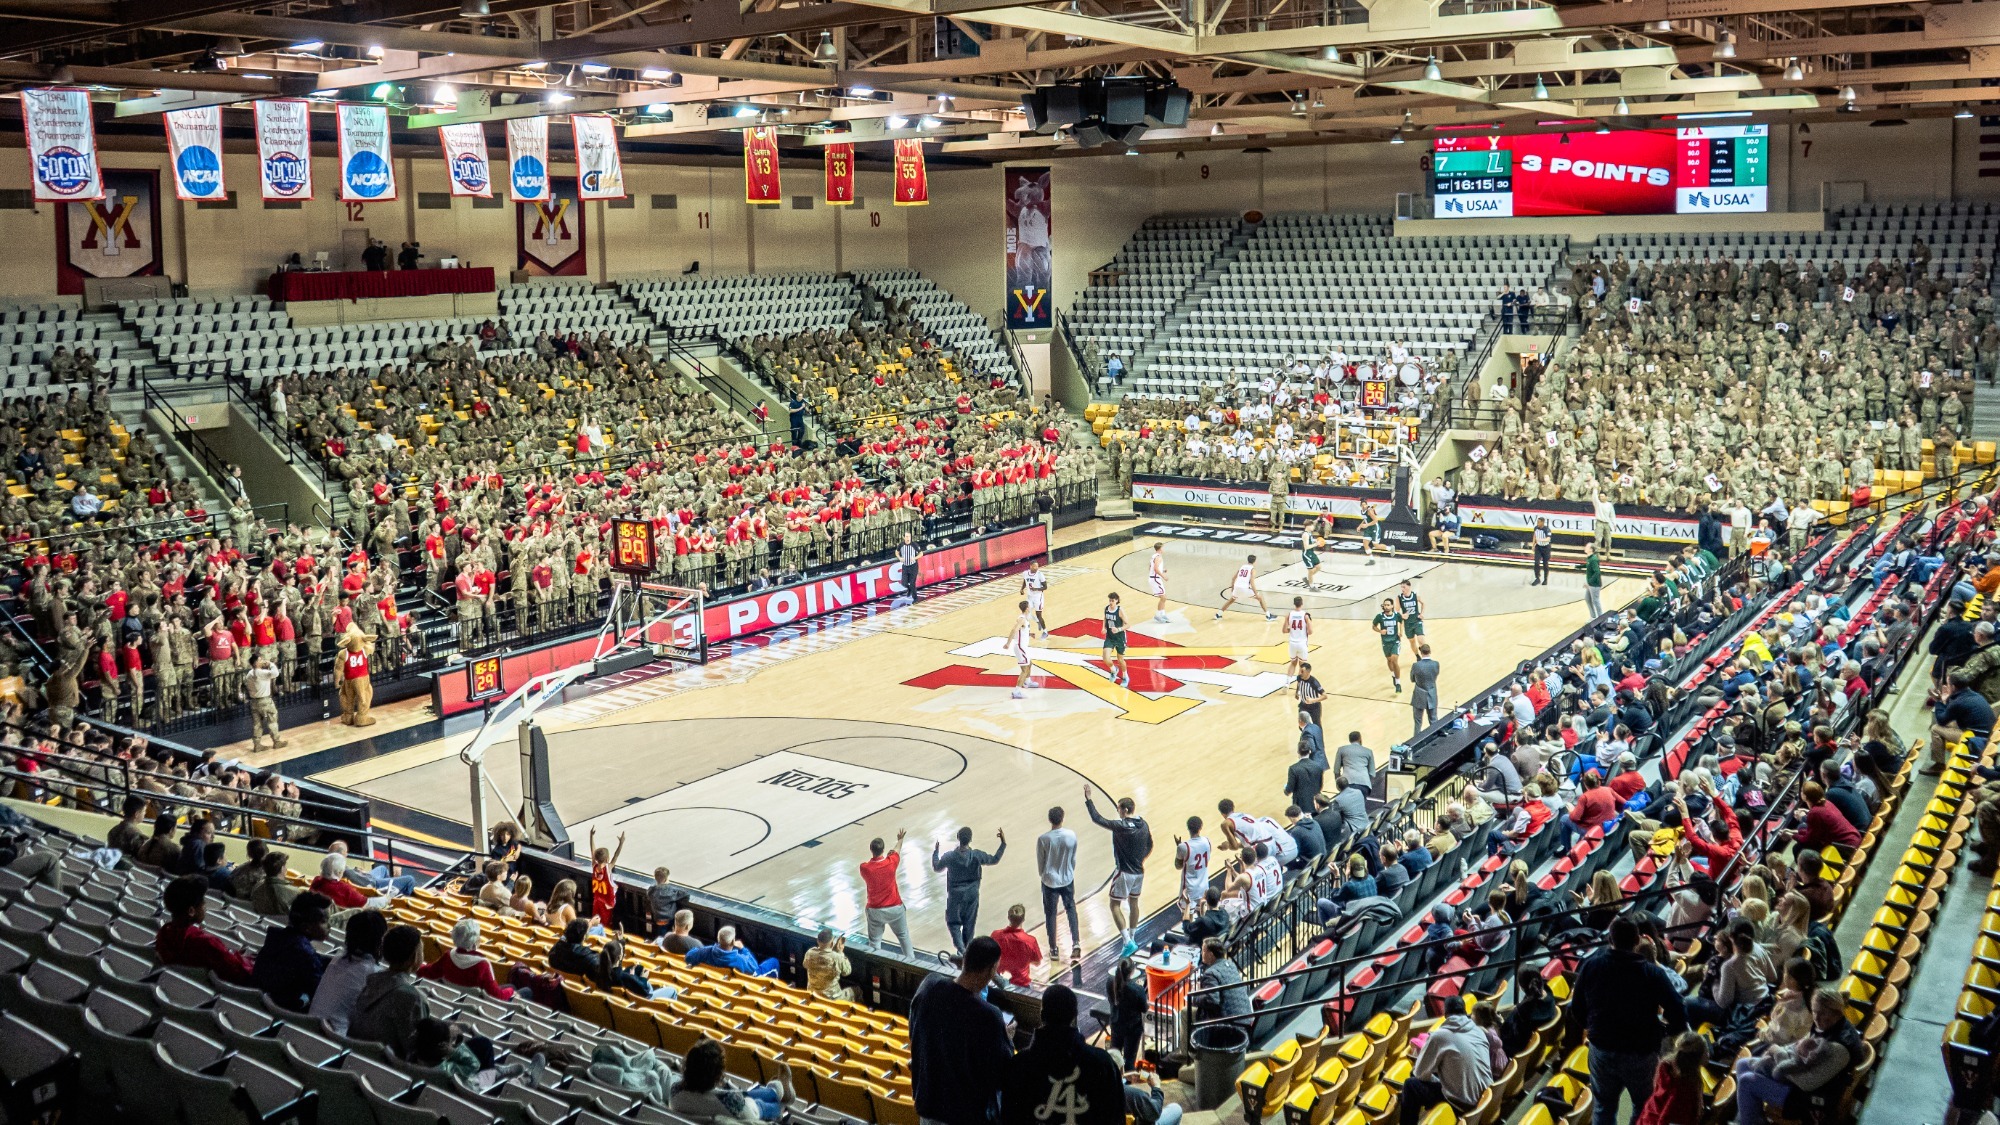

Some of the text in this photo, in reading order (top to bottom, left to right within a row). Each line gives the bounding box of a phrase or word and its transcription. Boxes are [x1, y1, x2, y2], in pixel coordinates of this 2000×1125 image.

[37, 106, 78, 116] Southern
[266, 114, 299, 124] Southern
[353, 118, 375, 127] NCAA
[345, 128, 384, 138] Tournament
[1801, 141, 1813, 158] 7
[38, 154, 92, 182] SOCON
[265, 159, 307, 184] SOCON
[452, 159, 488, 182] SOCON
[756, 157, 771, 175] 13
[833, 161, 847, 178] 33
[902, 163, 917, 179] 55
[1200, 164, 1210, 179] 9
[1435, 156, 1449, 171] 7
[1520, 154, 1670, 187] 3 POINTS
[183, 169, 220, 183] NCAA
[350, 172, 390, 186] NCAA
[515, 174, 545, 188] NCAA
[1437, 179, 1509, 191] 1ST 16:15 30
[1466, 199, 1499, 211] USAA
[1713, 193, 1751, 206] USAA
[345, 201, 364, 222] 12
[697, 211, 710, 229] 11
[869, 211, 881, 228] 10
[1006, 227, 1017, 254] MOE
[1366, 391, 1385, 405] 29
[1184, 490, 1210, 503] ONE
[1217, 492, 1256, 507] CORPS
[1306, 498, 1333, 513] VMI
[619, 521, 647, 539] 16:15
[1648, 522, 1696, 539] TEAM
[621, 538, 645, 563] 29
[1238, 569, 1249, 578] 30
[673, 562, 909, 649] 3 POINTS
[1291, 619, 1304, 631] 44
[349, 655, 364, 668] 84
[477, 674, 494, 691] 29
[541, 680, 566, 701] Schelde
[756, 768, 871, 800] SOCON
[1194, 850, 1209, 871] 21
[1273, 869, 1281, 886] 2
[1256, 878, 1266, 898] 14
